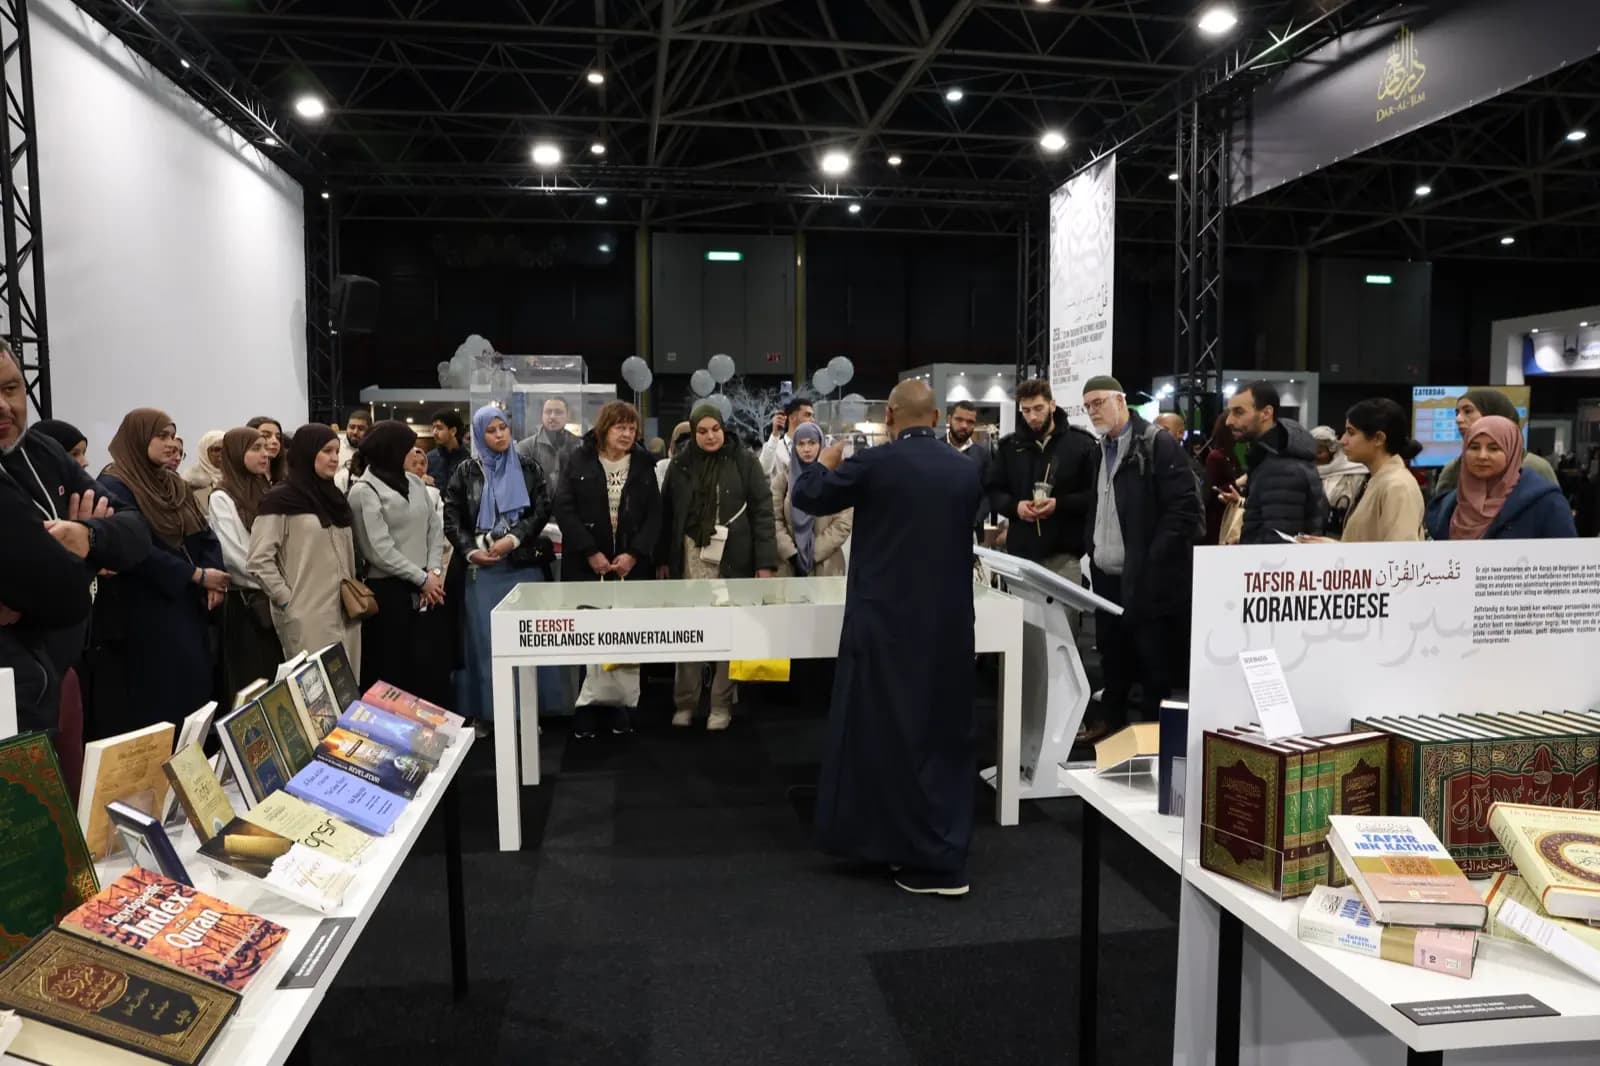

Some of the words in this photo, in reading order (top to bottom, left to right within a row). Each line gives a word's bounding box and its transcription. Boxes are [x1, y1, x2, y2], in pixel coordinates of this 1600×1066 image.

[1244, 570, 1295, 593] TAFSIR
[1298, 568, 1372, 592] AL-QURAN
[1243, 593, 1390, 624] KORANEXEGESE
[519, 619, 533, 633] DE
[535, 618, 575, 633] EERSTE
[519, 632, 595, 648] NEDERLANDSE
[598, 629, 704, 646] KORANVERTALINGEN
[1354, 842, 1381, 850] IBN
[1384, 843, 1439, 852] KATHIR
[1361, 833, 1419, 843] TAFSIR
[121, 892, 194, 939] Index
[165, 909, 223, 948] Quran
